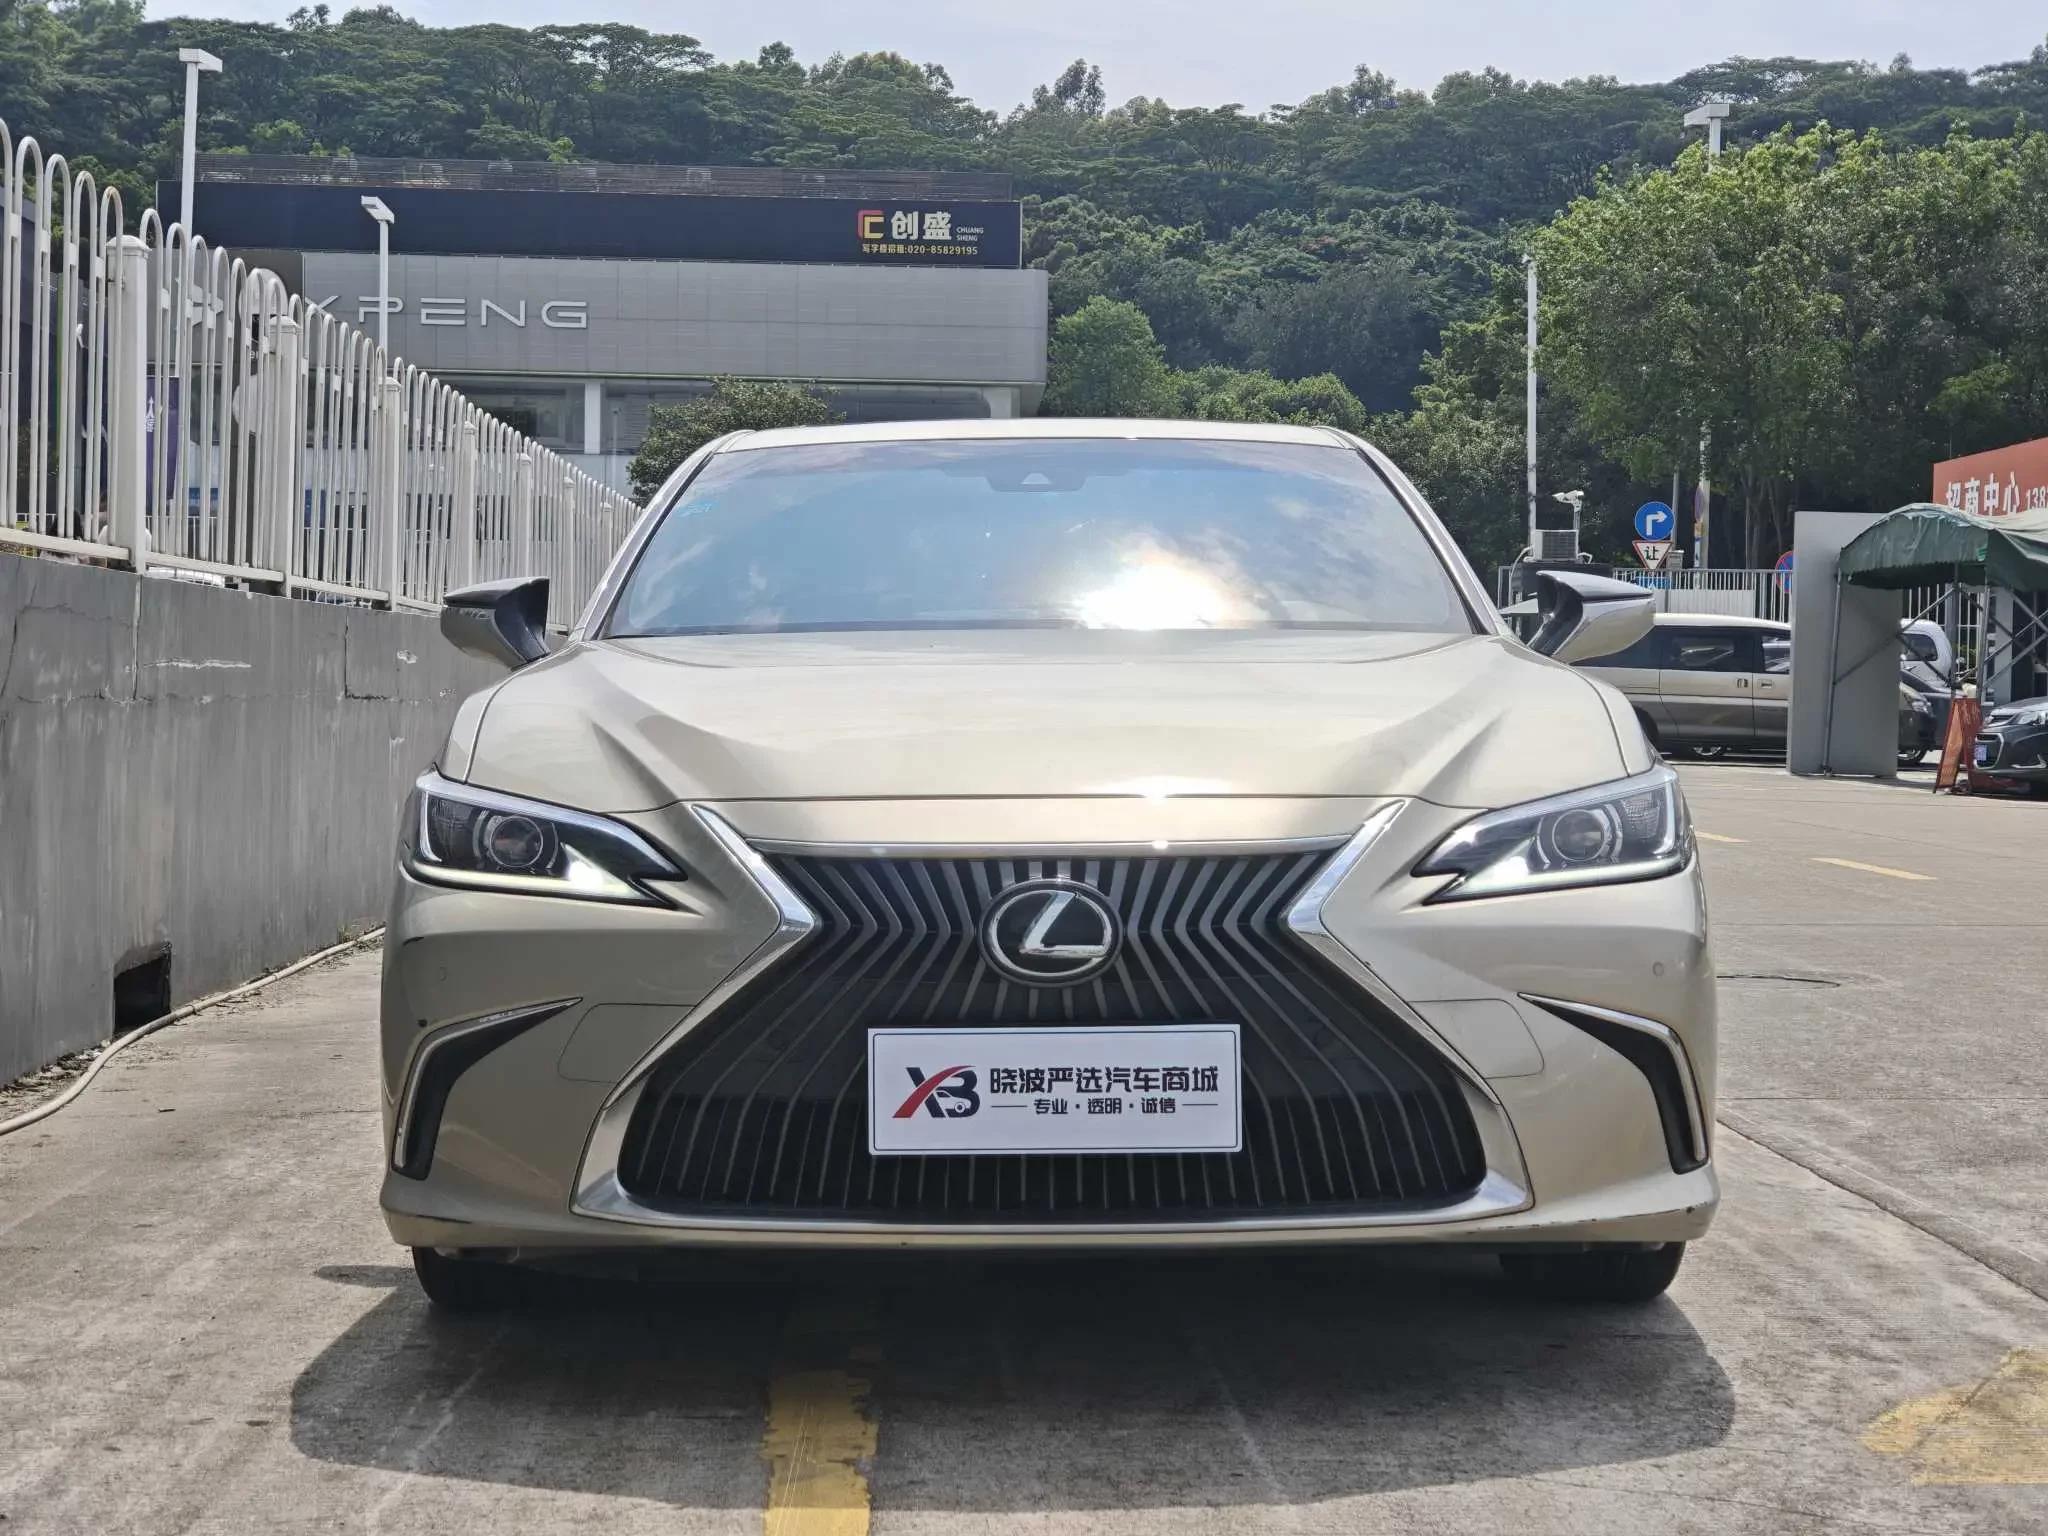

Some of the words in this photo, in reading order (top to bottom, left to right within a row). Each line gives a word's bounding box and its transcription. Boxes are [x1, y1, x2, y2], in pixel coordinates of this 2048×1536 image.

[891, 210, 952, 241] 创盛
[955, 226, 984, 234] CHUANG
[1644, 545, 1659, 561] 让
[989, 1065, 1219, 1094] 晓波严选汽车商城
